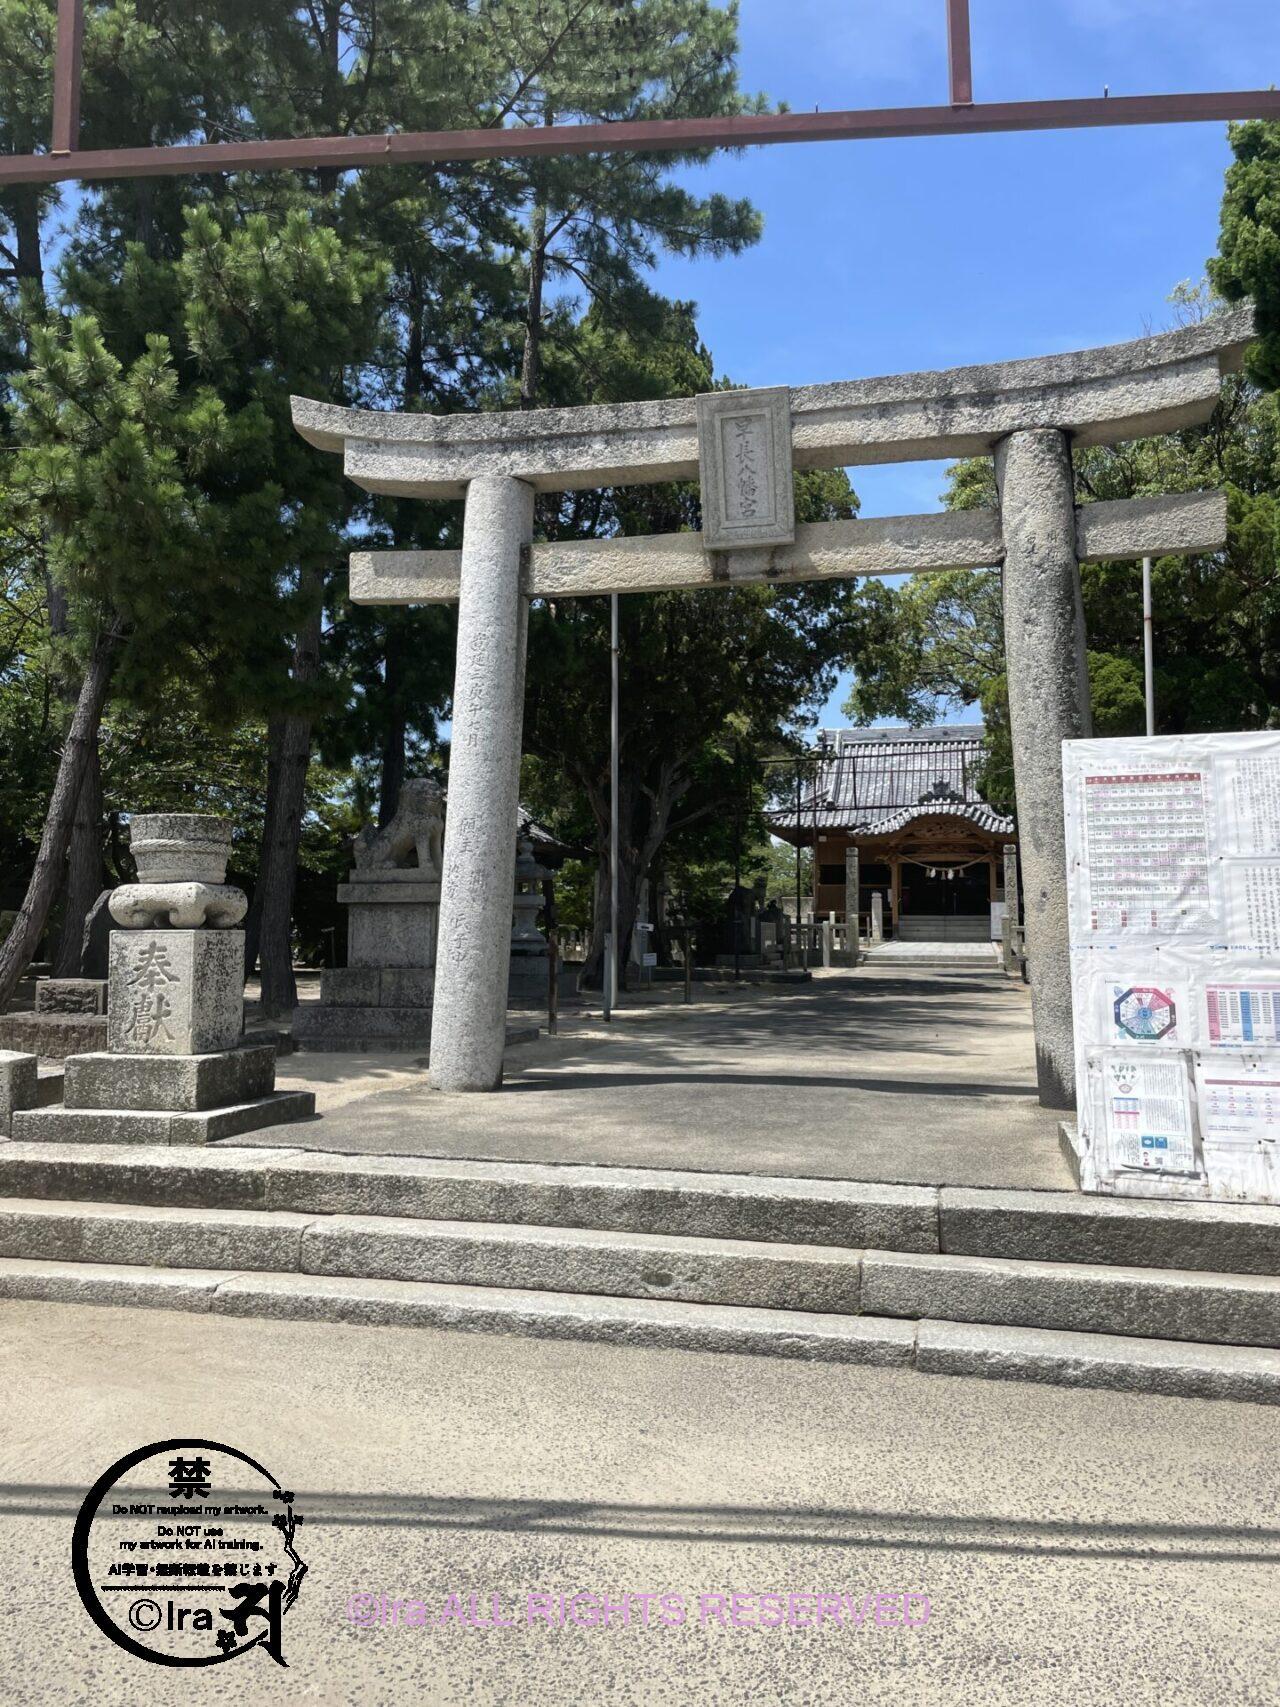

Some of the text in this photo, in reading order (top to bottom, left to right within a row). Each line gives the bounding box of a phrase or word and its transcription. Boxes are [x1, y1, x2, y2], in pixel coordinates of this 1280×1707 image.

[735, 417, 759, 519] 早長八幡宮
